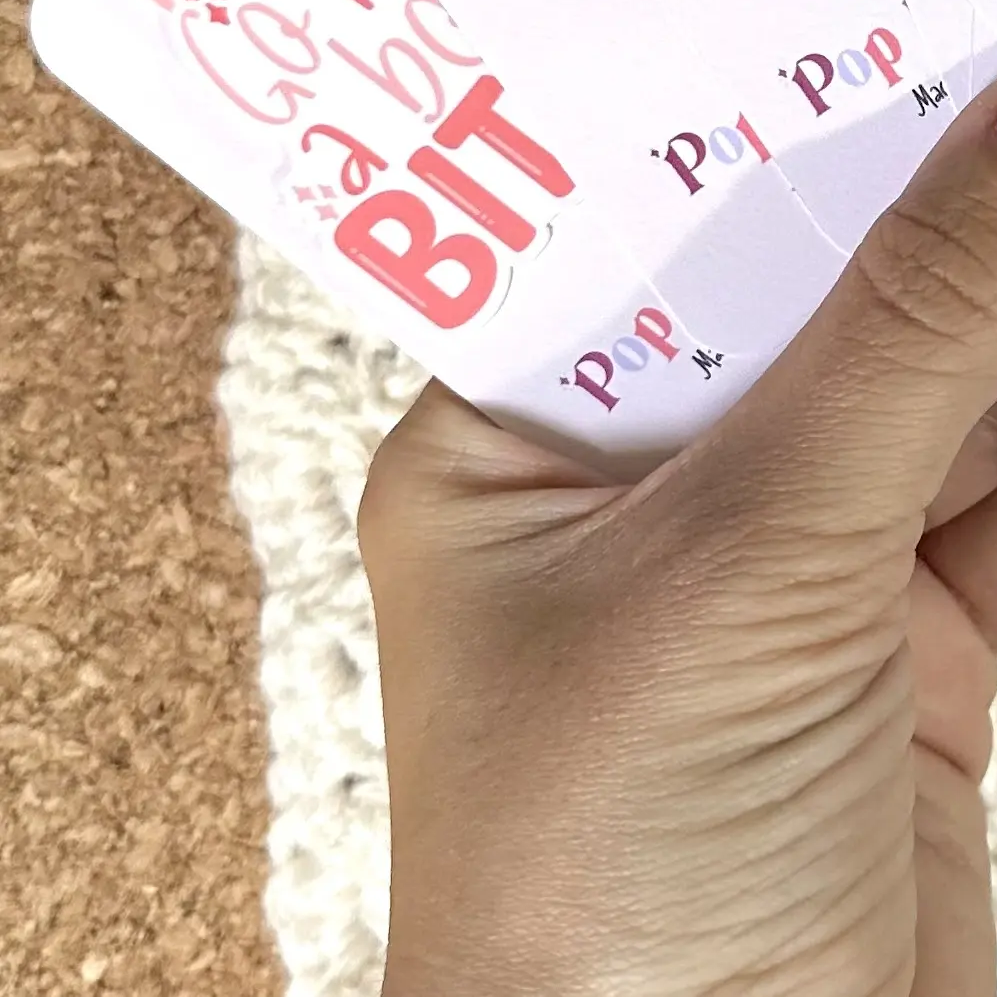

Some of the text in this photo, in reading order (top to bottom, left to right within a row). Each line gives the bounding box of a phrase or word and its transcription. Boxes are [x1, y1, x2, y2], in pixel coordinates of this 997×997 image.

[180, 1, 321, 125] Go
[792, 27, 904, 118] Pop
[302, 124, 389, 194] a
[334, 74, 576, 330] BIT
[574, 307, 681, 413] Pop
